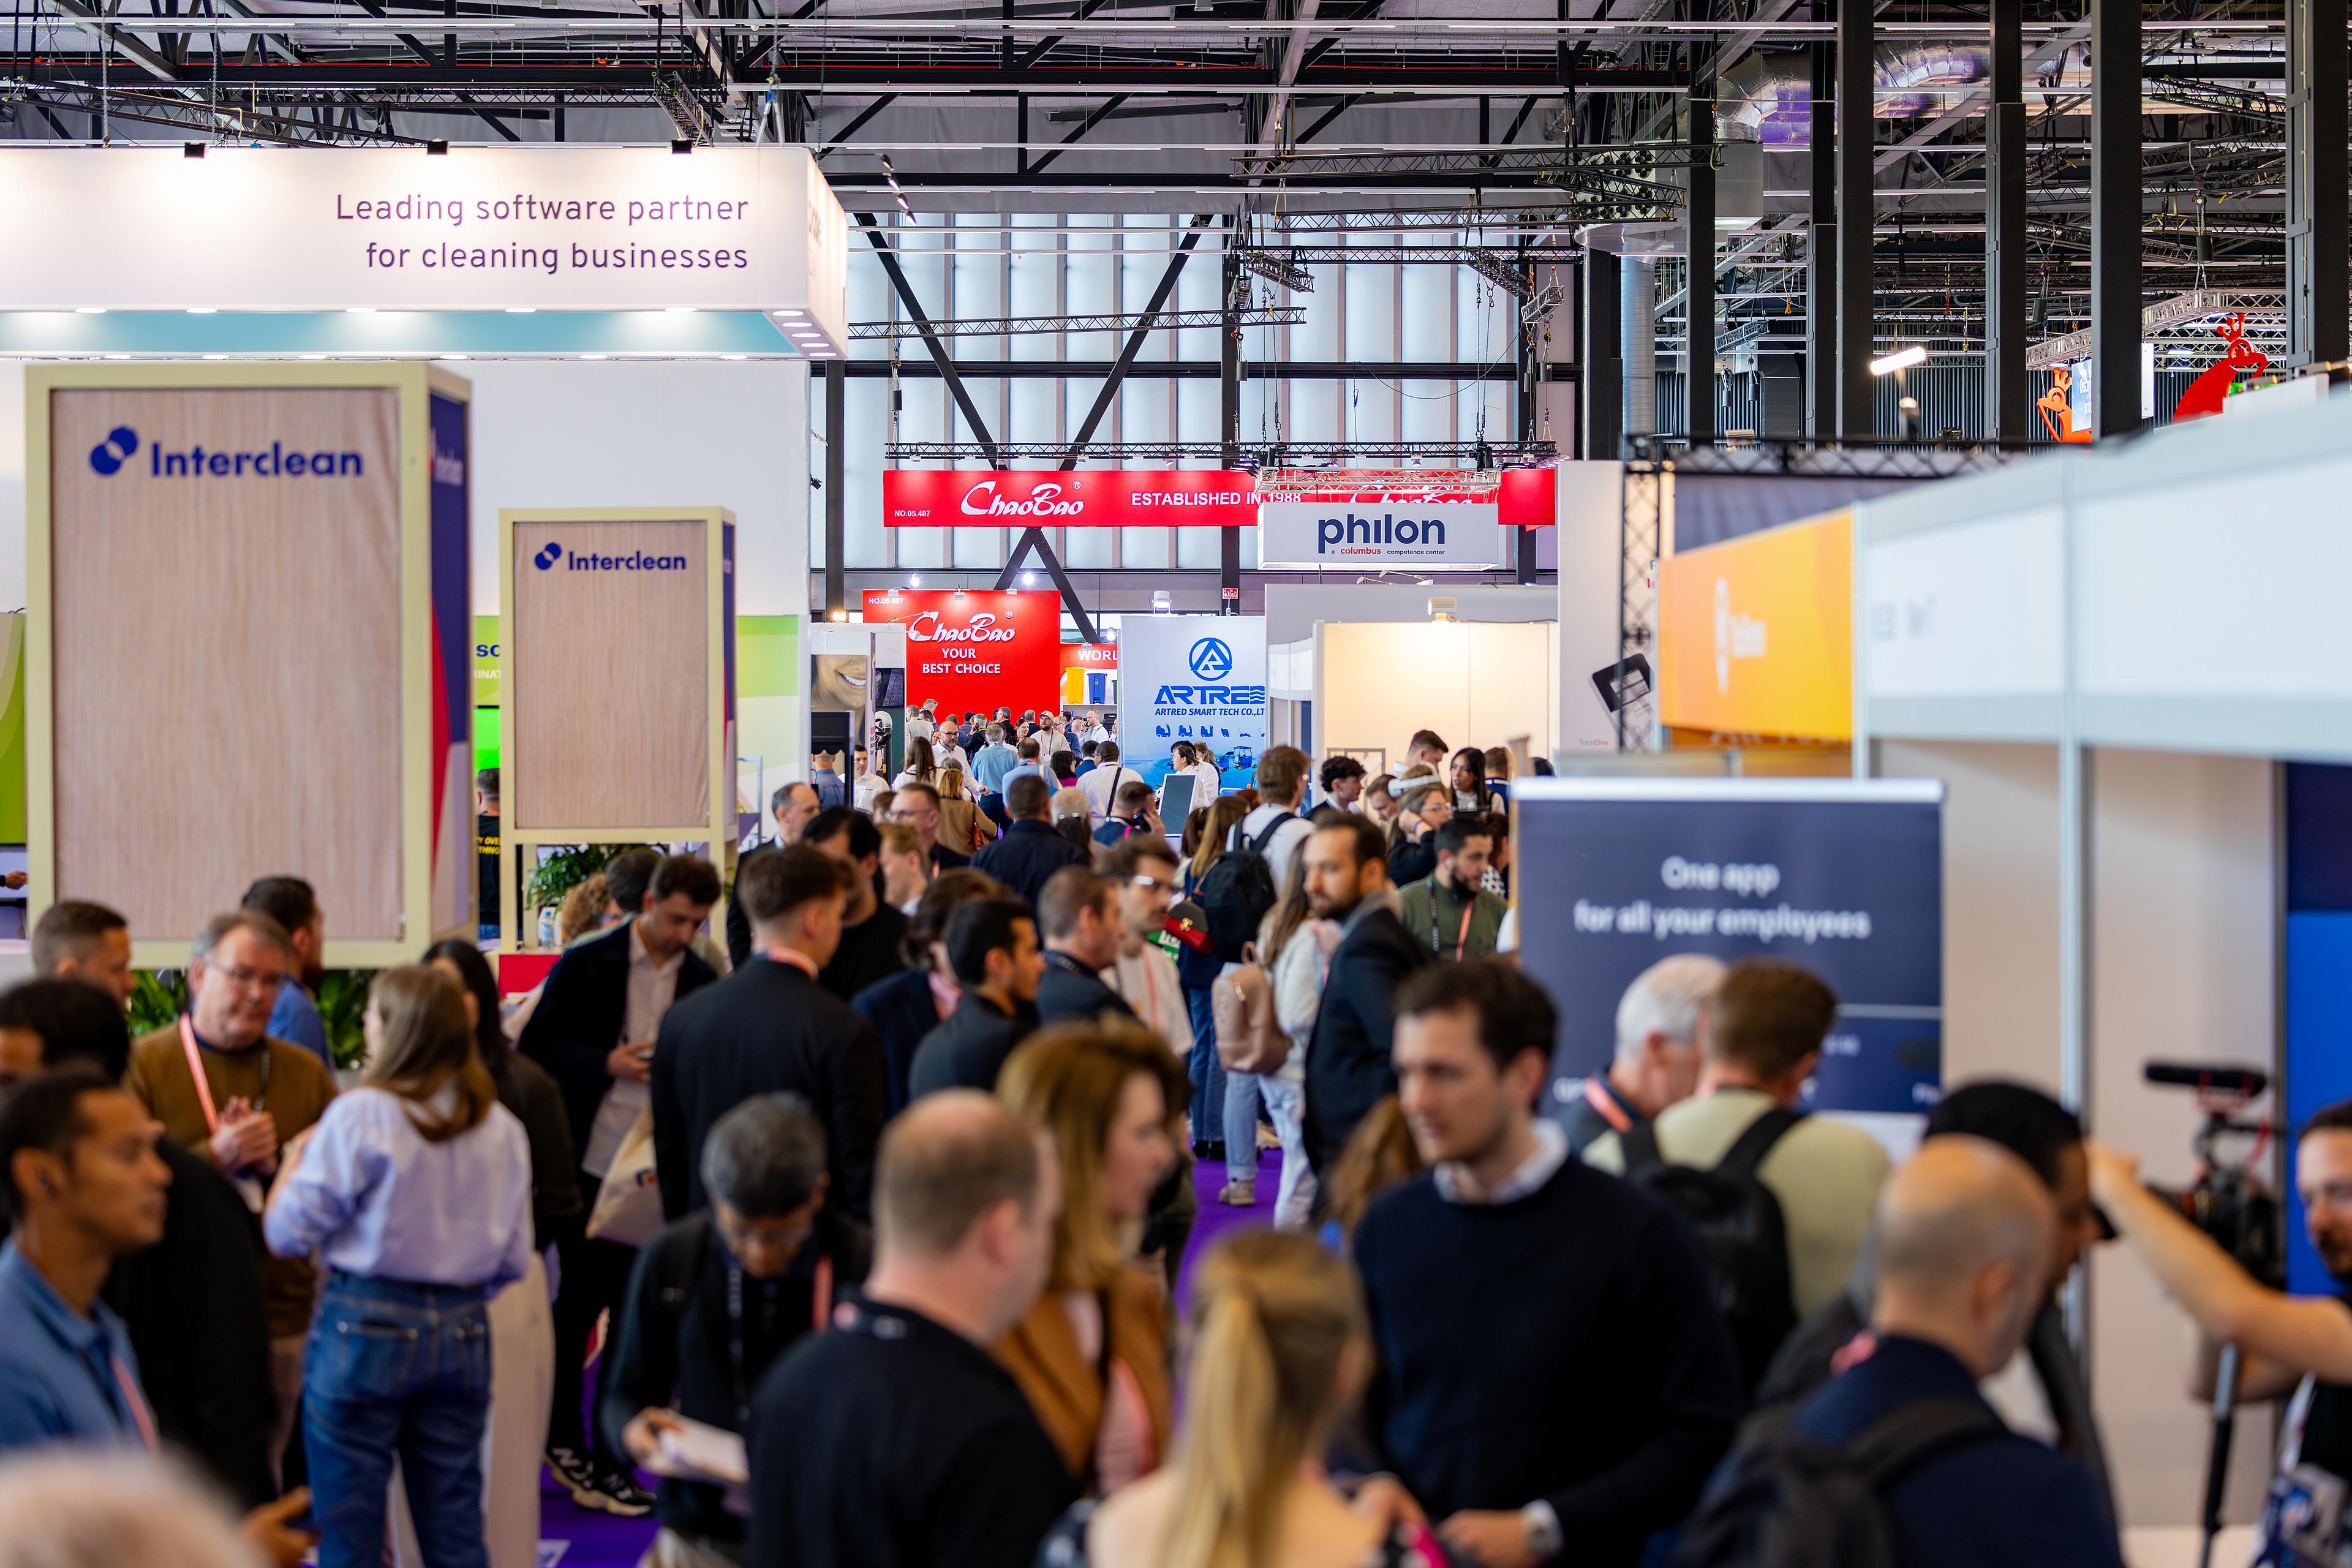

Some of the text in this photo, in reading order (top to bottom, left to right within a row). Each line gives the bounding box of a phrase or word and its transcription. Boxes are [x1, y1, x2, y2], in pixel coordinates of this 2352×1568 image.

[337, 194, 748, 227] Leading software partner
[366, 242, 748, 275] for cleaning businesses
[152, 442, 364, 477] Interclean
[960, 481, 1084, 517] ChaoBao
[1131, 492, 1302, 505] ESTABLISHED IN 1988
[1317, 513, 1446, 554] philon
[568, 550, 687, 571] Interclean
[908, 611, 1016, 643] ChaoBao
[922, 663, 1000, 673] BEST CHOICE
[941, 648, 976, 658] YOUR
[1077, 650, 1118, 662] WORL
[1660, 855, 1781, 899] One app
[1573, 898, 1872, 944] for all your employees
